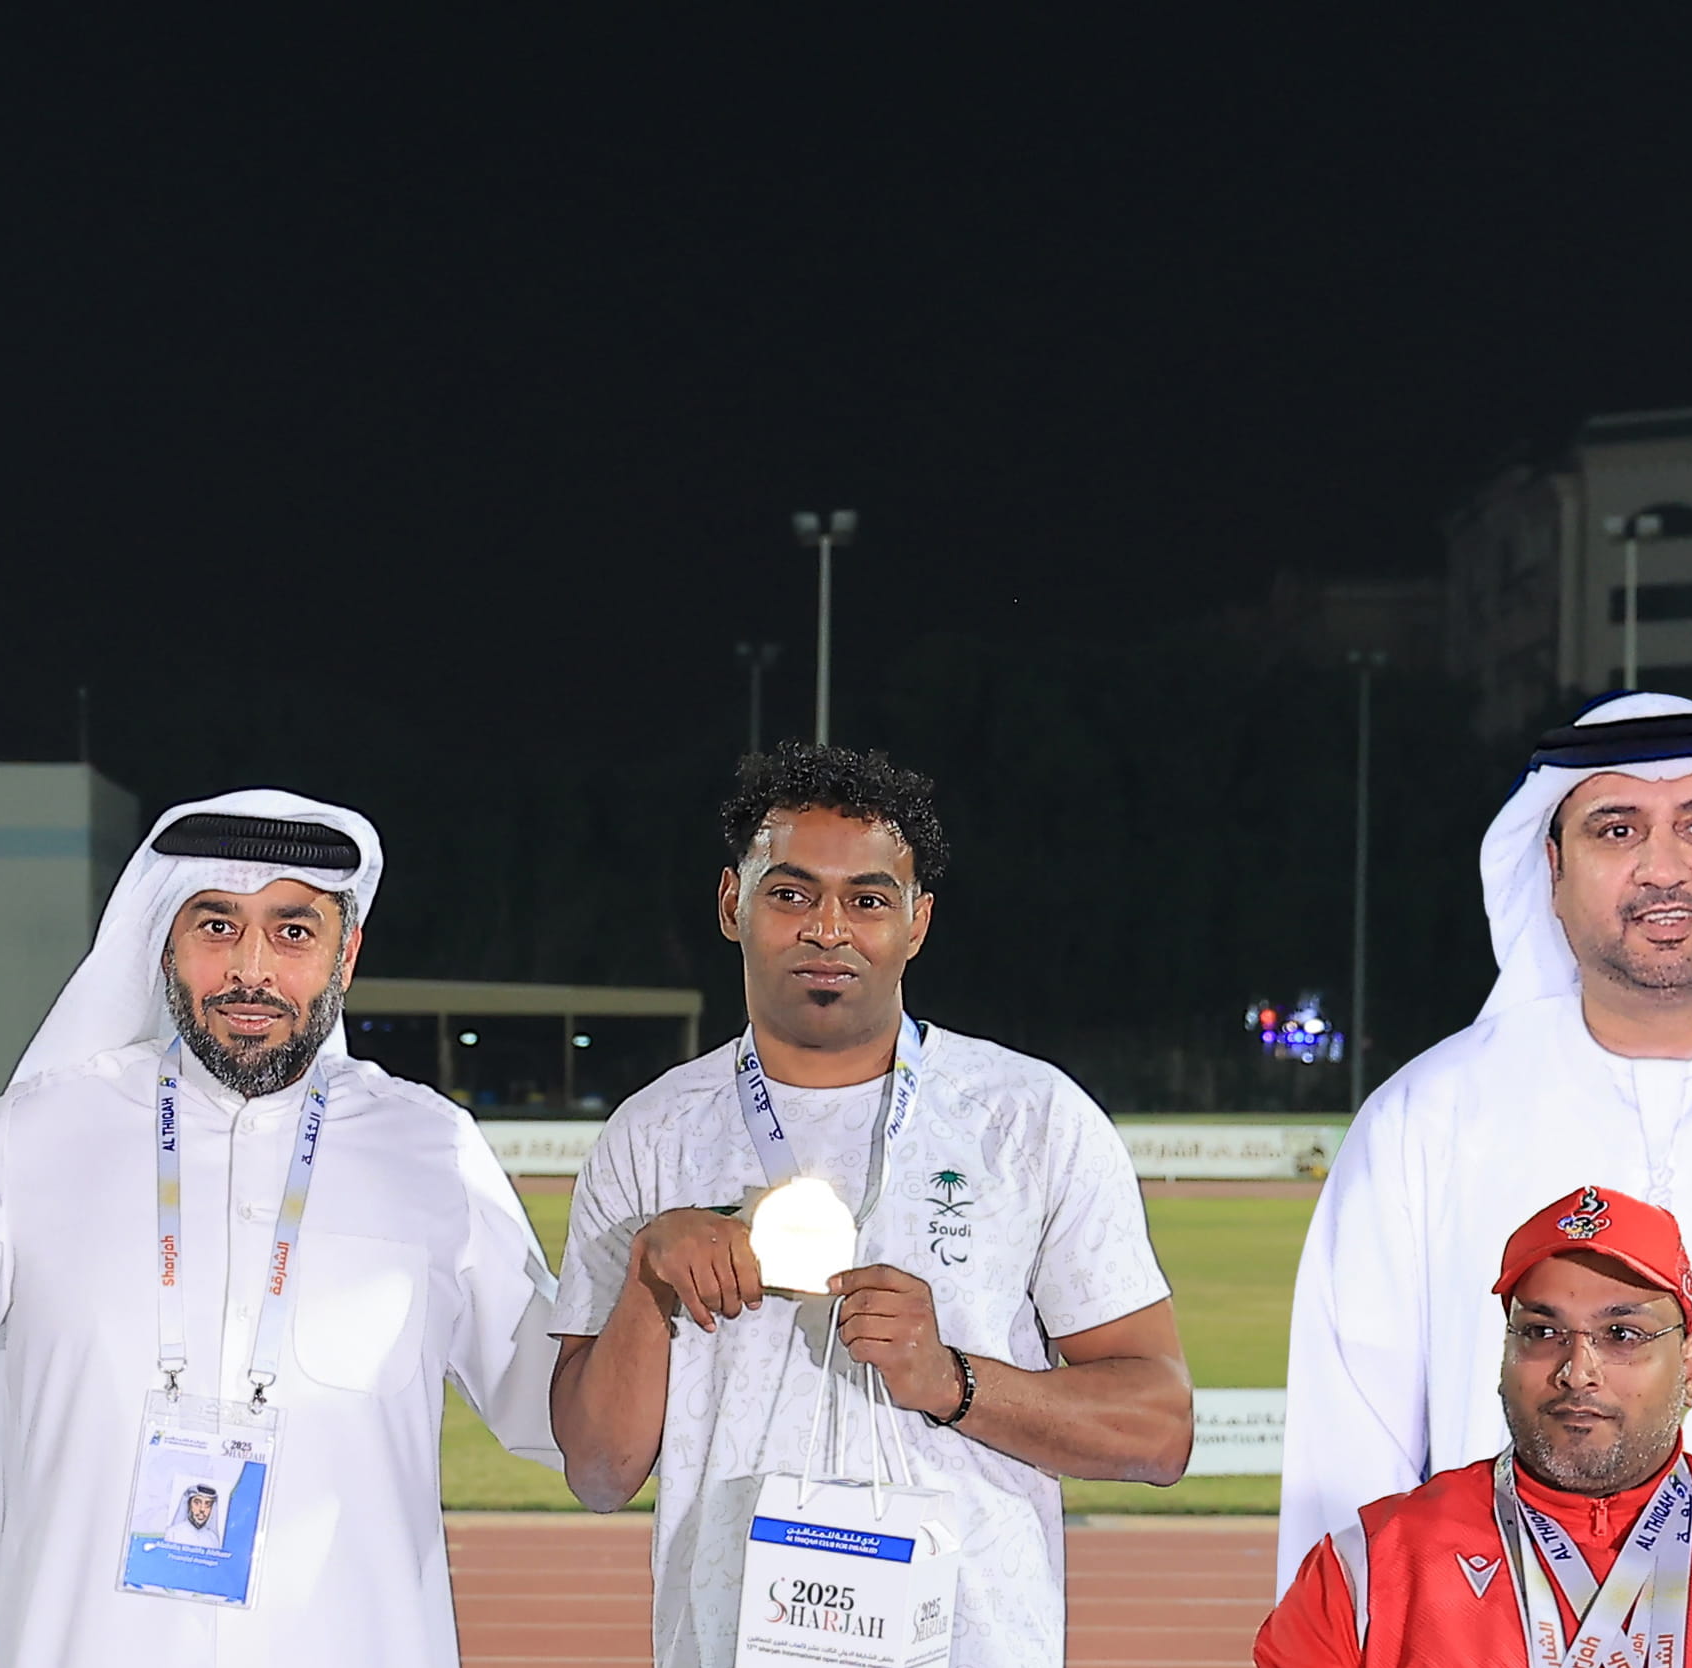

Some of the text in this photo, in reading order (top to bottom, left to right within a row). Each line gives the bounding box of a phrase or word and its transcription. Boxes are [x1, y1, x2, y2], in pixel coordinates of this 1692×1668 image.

[162, 1097, 176, 1152] AL THIQAH
[928, 1221, 972, 1238] Saudi
[161, 1235, 178, 1287] Sharjah
[269, 1241, 290, 1296] الشارقة
[1636, 1492, 1676, 1552] AL THIQAH
[1551, 1543, 1572, 1560] AL
[791, 1580, 855, 1611] 2025
[766, 1601, 886, 1640] SHARJAH
